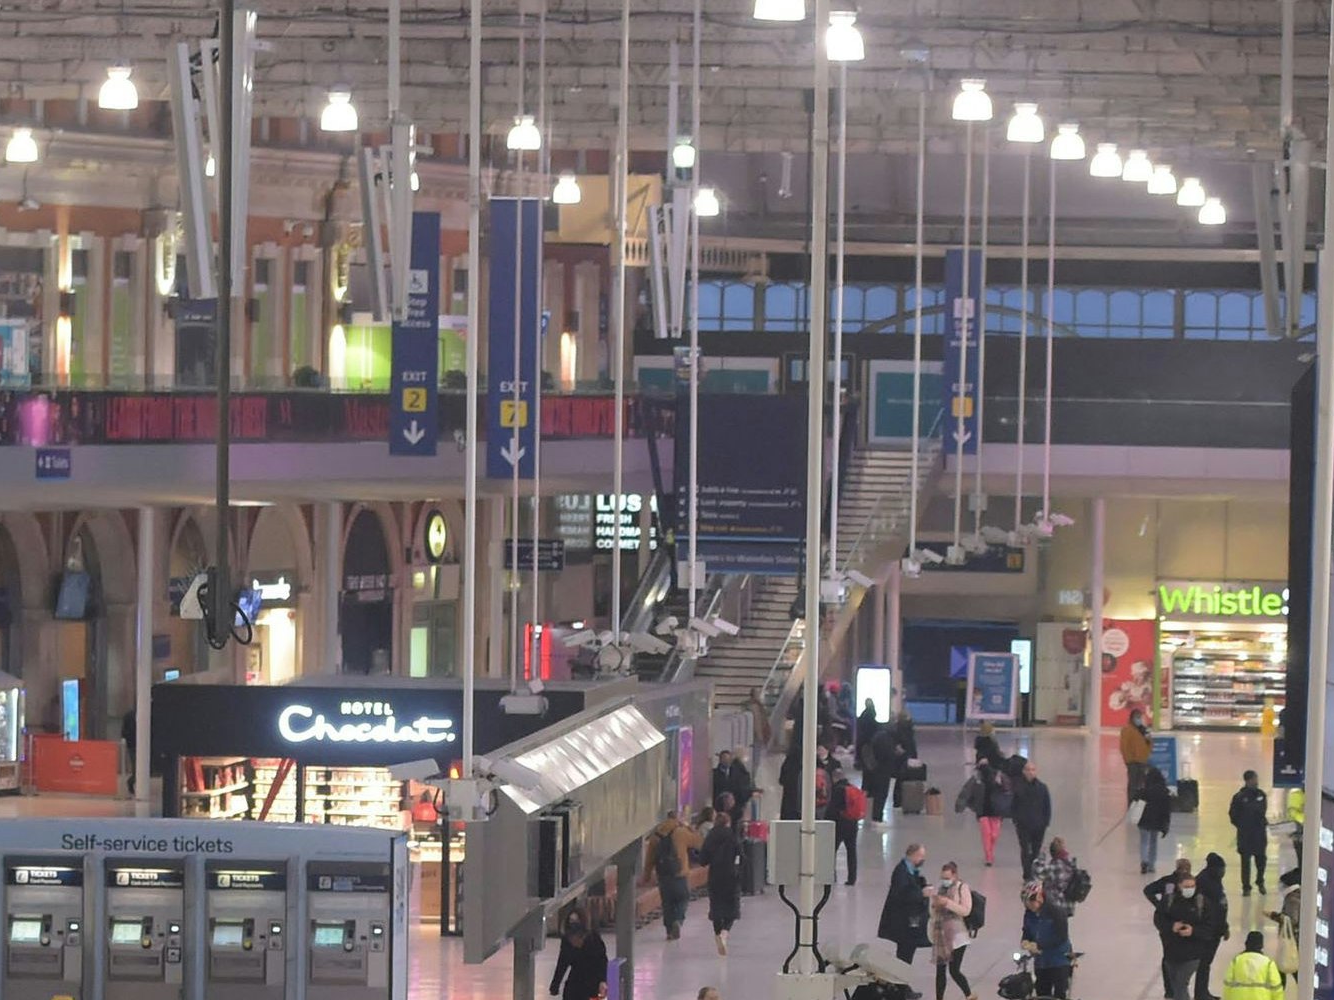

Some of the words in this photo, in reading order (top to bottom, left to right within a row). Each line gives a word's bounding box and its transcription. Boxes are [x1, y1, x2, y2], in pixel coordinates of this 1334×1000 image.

[402, 371, 427, 381] EXIT
[500, 381, 528, 392] EXT
[409, 391, 420, 408] 2
[341, 702, 393, 715] HOTEL
[61, 833, 167, 852] Self-service
[174, 834, 233, 853] tickets
